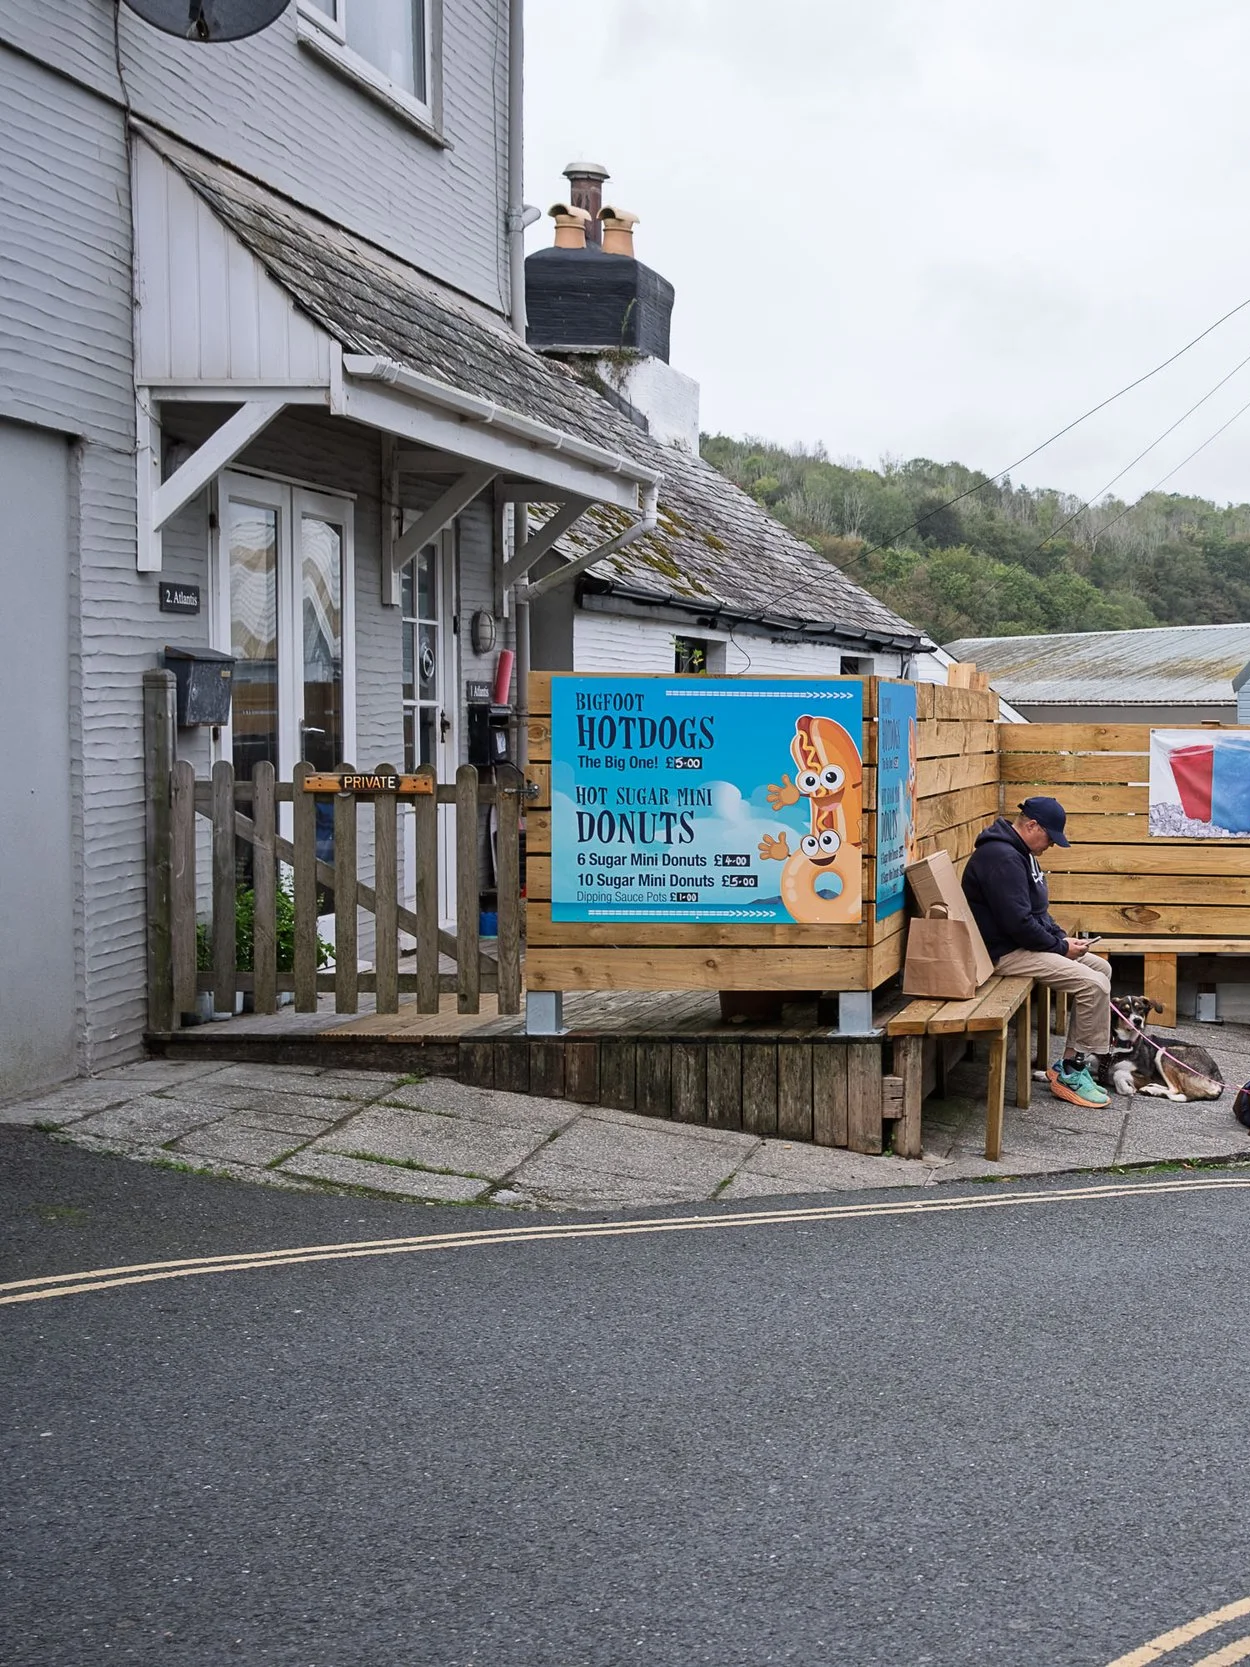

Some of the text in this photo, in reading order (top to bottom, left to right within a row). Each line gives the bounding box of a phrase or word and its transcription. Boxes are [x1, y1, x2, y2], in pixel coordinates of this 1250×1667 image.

[173, 591, 198, 606] Atlantis
[576, 692, 645, 711] BIGFOOT
[576, 714, 715, 751] HOTDOGS
[577, 755, 601, 769] The
[604, 755, 626, 771] Big
[629, 755, 658, 769] One!
[344, 776, 396, 789] PRIVATE
[576, 786, 713, 807] HOT SUGAR MINI
[576, 809, 695, 845] DONUTS
[577, 853, 586, 866] 6
[589, 853, 627, 869] Sugar
[630, 853, 658, 866] Mini
[662, 853, 707, 867] Donuts
[577, 873, 594, 886] 10
[596, 873, 635, 889] Sugar
[638, 874, 666, 887] Mini
[669, 874, 715, 888] Donuts
[577, 891, 612, 904] Dipping
[615, 891, 643, 903] Sauce
[646, 892, 667, 903] Pots
